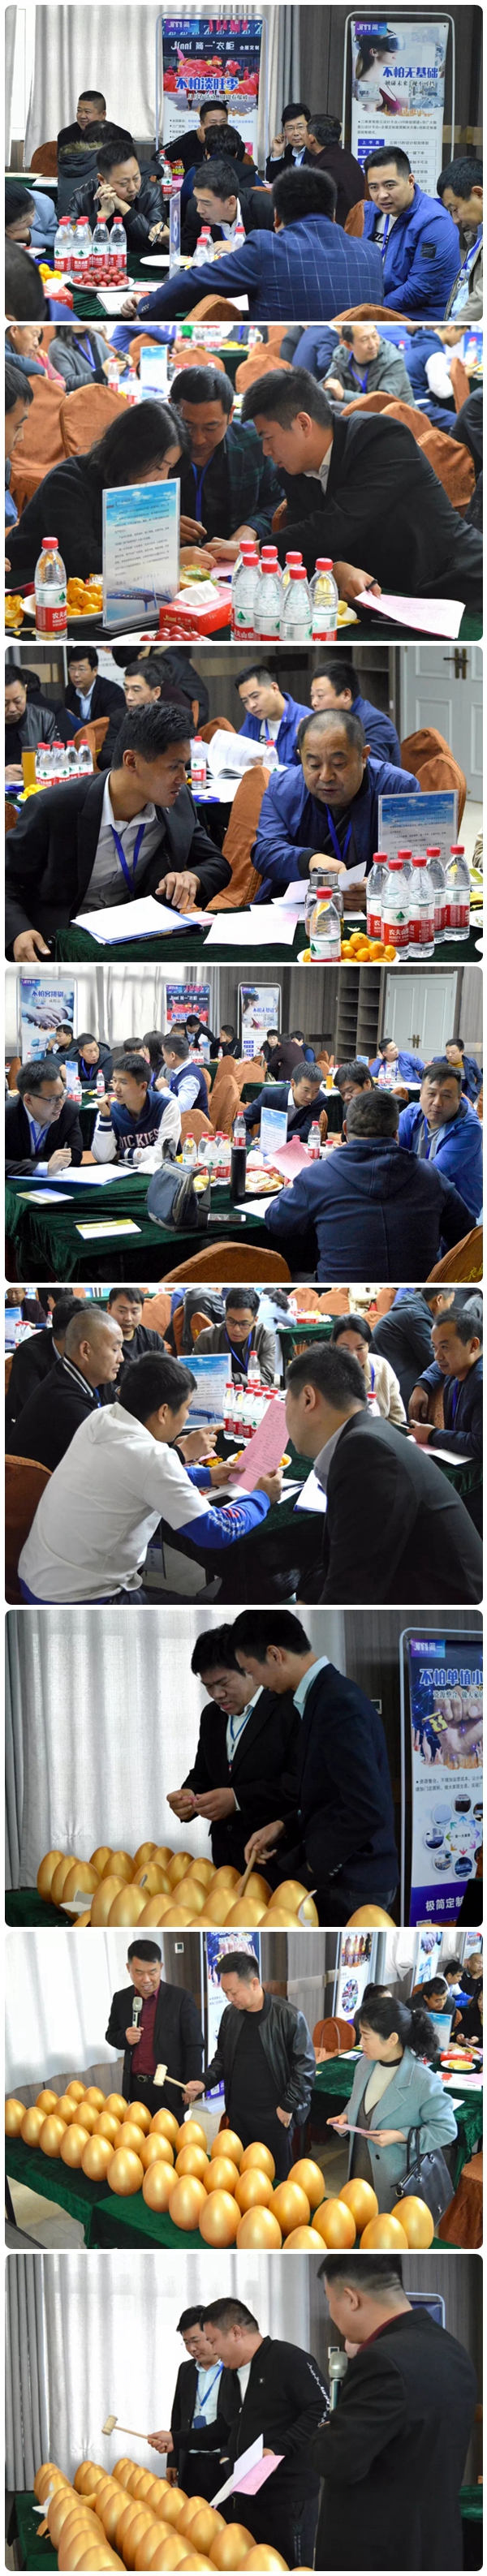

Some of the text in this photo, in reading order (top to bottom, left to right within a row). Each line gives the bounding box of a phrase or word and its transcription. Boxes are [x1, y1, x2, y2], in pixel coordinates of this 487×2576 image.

[382, 67, 438, 79] 不怕无基础
[175, 76, 239, 91] 不怕淡旺季
[234, 630, 254, 639] 夫山泉
[420, 1668, 484, 1686] 不怕单值小
[433, 1690, 458, 1700] 资源整合
[425, 1895, 464, 1912] 极简定制
